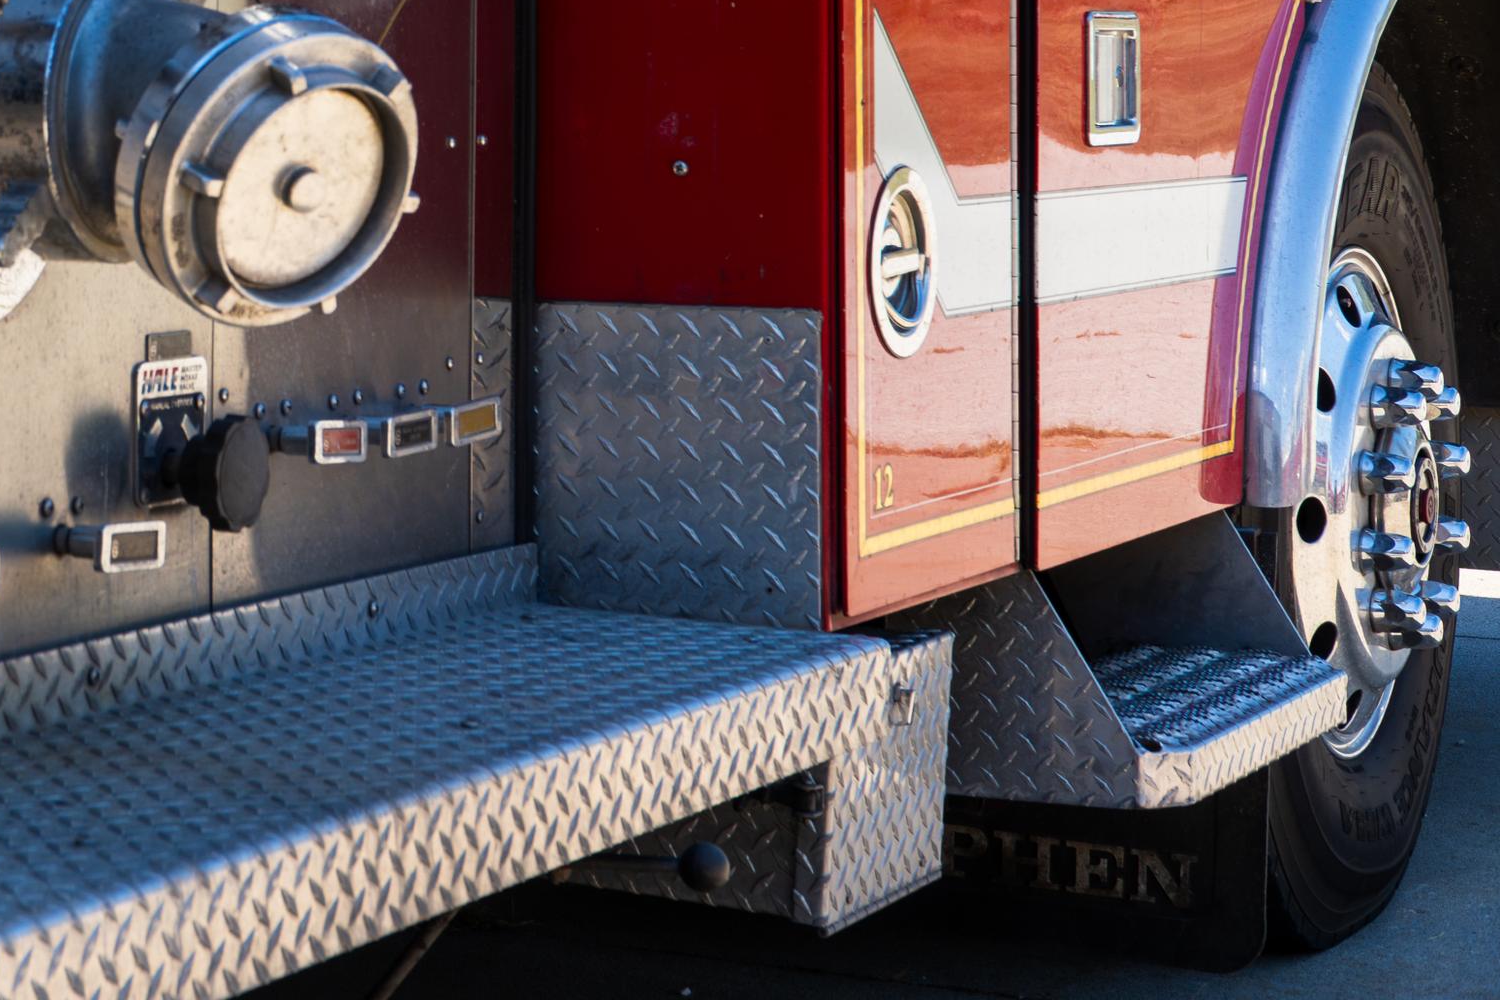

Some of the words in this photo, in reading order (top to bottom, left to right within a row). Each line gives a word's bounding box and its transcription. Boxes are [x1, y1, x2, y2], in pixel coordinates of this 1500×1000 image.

[1339, 155, 1401, 234] EAR
[141, 366, 180, 396] HALE
[873, 462, 895, 513] 12
